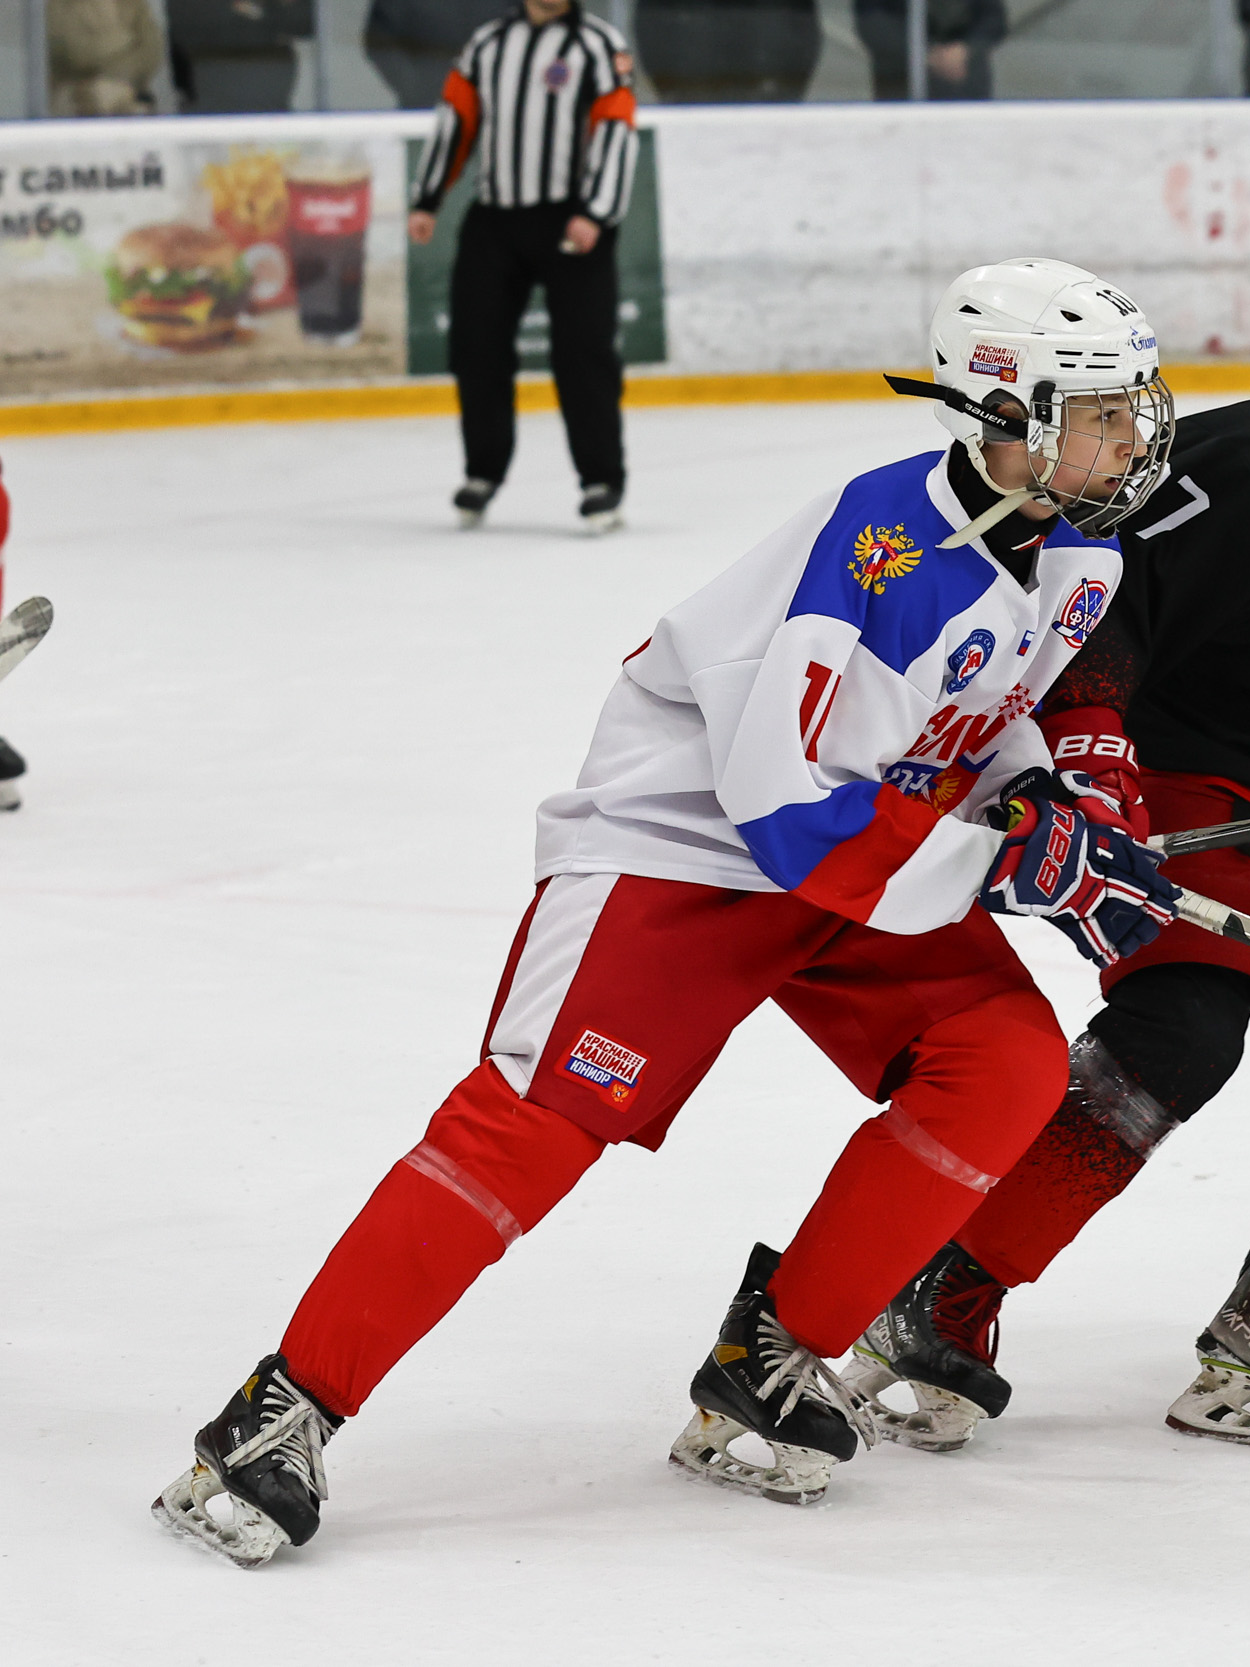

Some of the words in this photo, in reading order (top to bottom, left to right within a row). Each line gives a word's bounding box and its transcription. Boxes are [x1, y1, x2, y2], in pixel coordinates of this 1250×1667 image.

[1096, 289, 1138, 317] 10
[972, 351, 1014, 367] МАШИНА
[975, 343, 1007, 355] КРАСНАЯ
[973, 362, 1000, 374] ЮНИОР
[964, 402, 1007, 427] BAUER
[1054, 734, 1139, 772] BAU
[1034, 800, 1076, 899] BAU
[582, 1032, 630, 1060] КРАСНАЯ
[569, 1059, 612, 1084] ЮНИОР
[573, 1042, 637, 1081] МАШИНА
